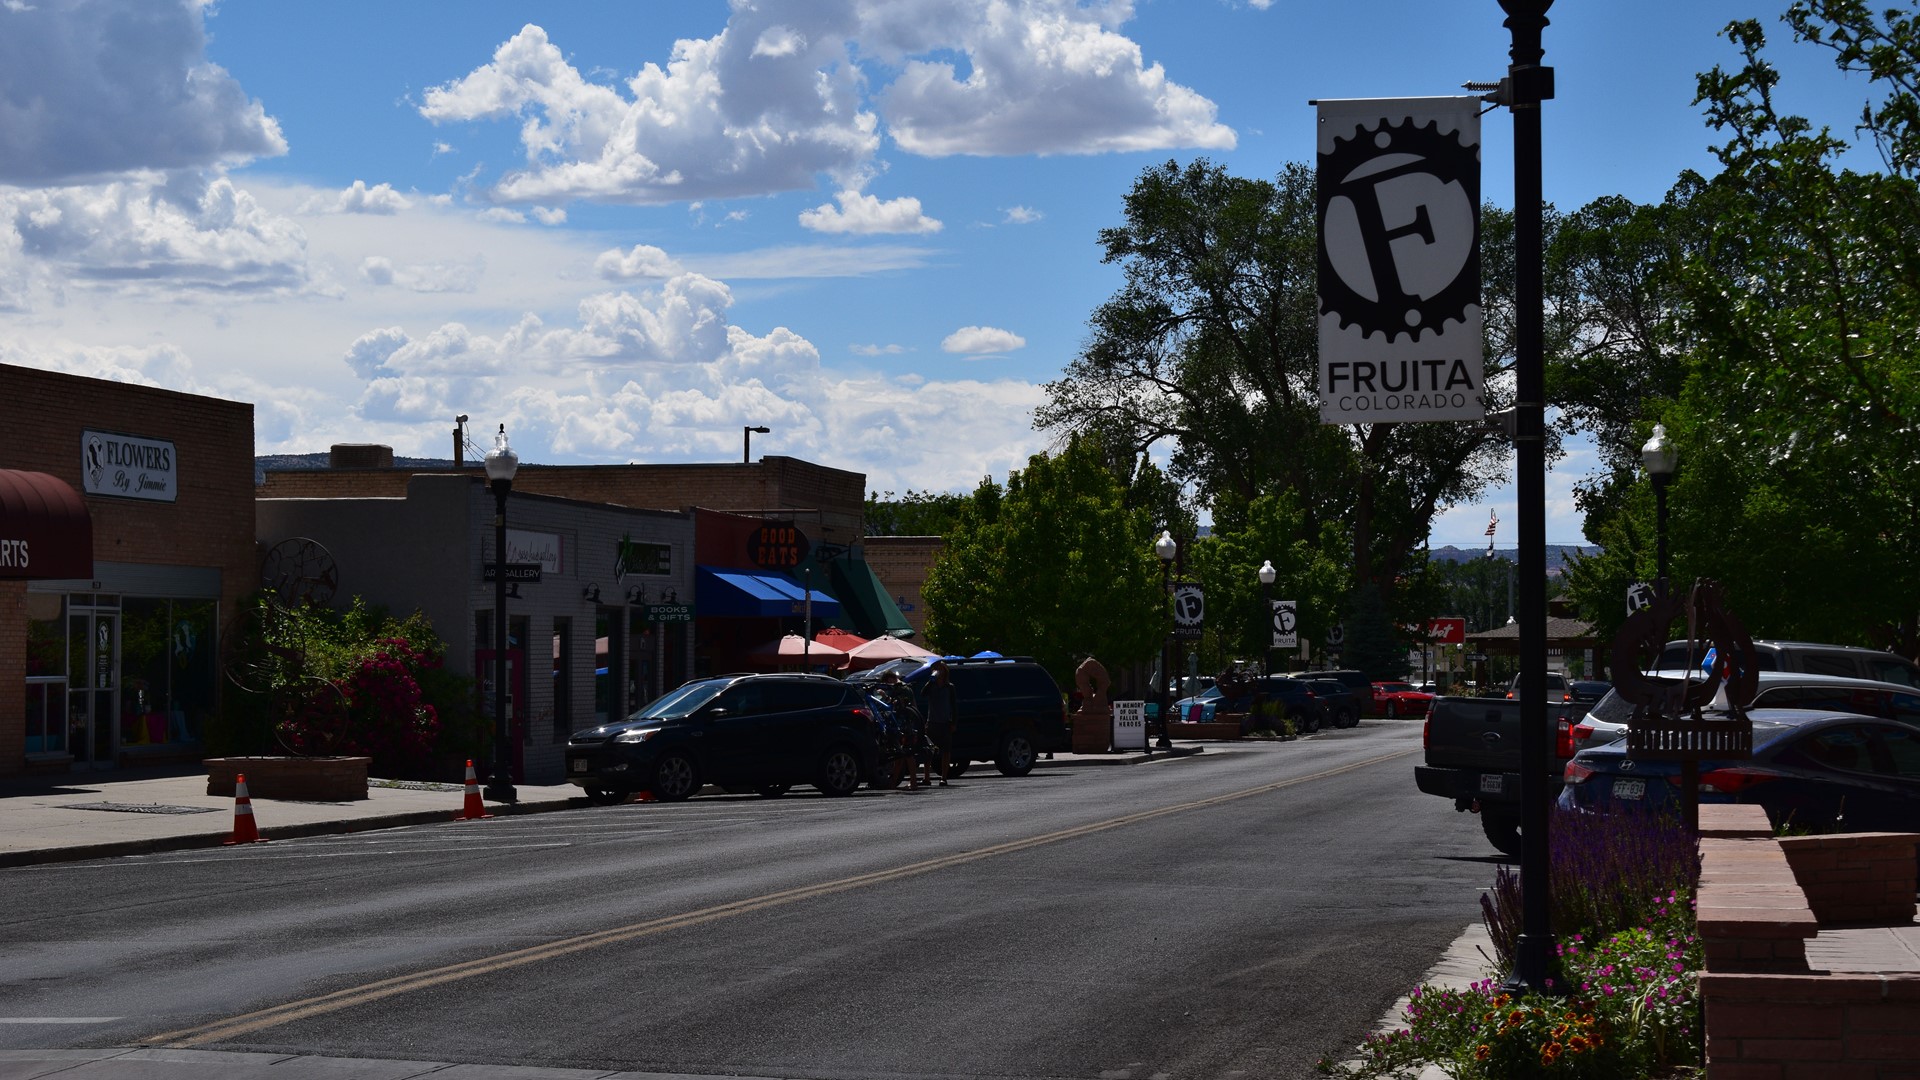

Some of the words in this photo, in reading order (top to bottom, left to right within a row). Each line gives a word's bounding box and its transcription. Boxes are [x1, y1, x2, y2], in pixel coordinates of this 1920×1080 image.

[1328, 359, 1474, 393] FRUITA
[1339, 393, 1465, 411] COLORADO
[106, 441, 170, 471] FLOWERS
[113, 470, 130, 491] By
[135, 473, 167, 493] Jimmie
[0, 539, 29, 568] RTS
[758, 546, 798, 566] EATS
[650, 606, 688, 614] BOOKS
